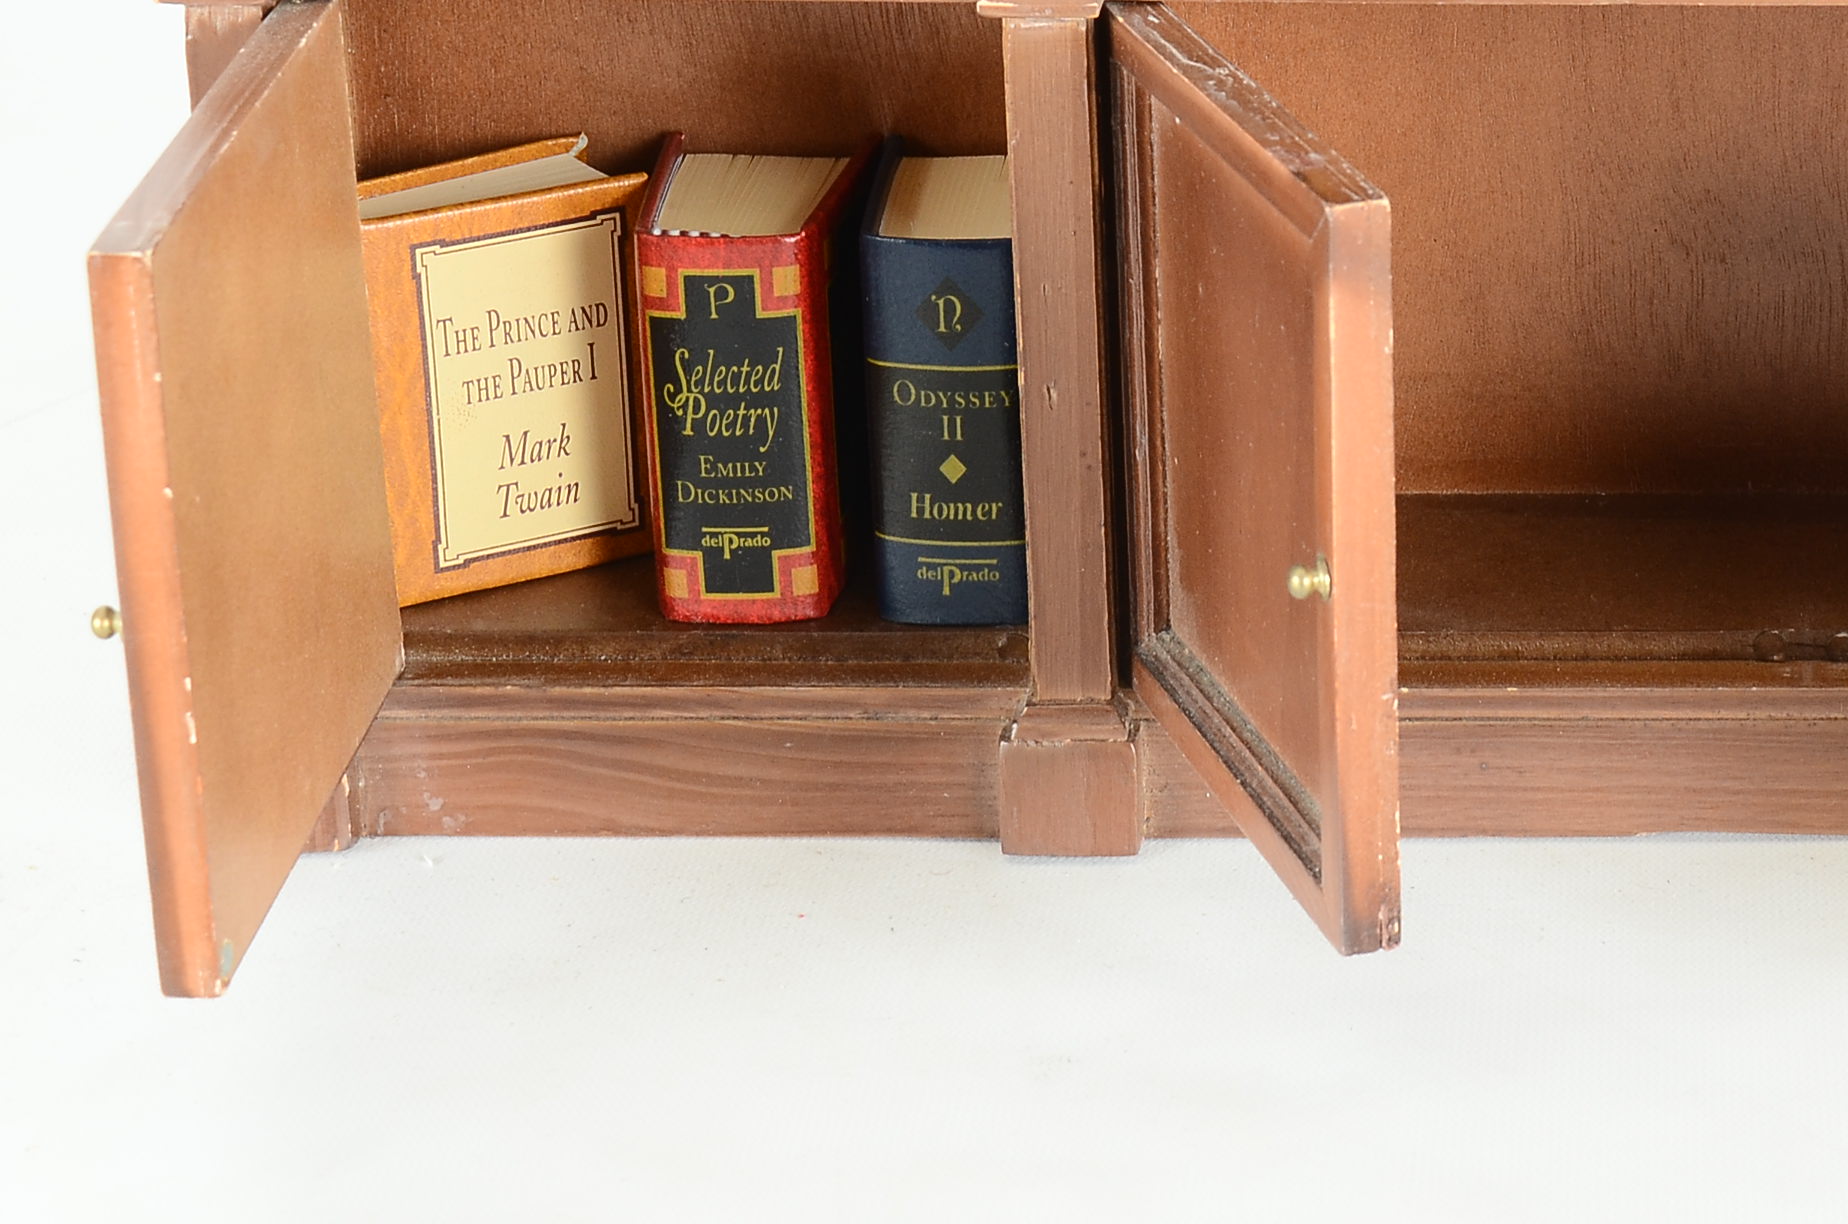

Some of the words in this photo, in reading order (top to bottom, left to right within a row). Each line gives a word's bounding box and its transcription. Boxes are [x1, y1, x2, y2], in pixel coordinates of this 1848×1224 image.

[436, 316, 482, 358] THE
[462, 374, 502, 406] THE
[588, 342, 598, 381] I
[664, 347, 784, 405] Selected
[669, 389, 778, 452] Poetry
[942, 416, 963, 441] II
[498, 423, 571, 470] Mark
[496, 472, 580, 519] Twain
[910, 492, 1003, 522] Homer
